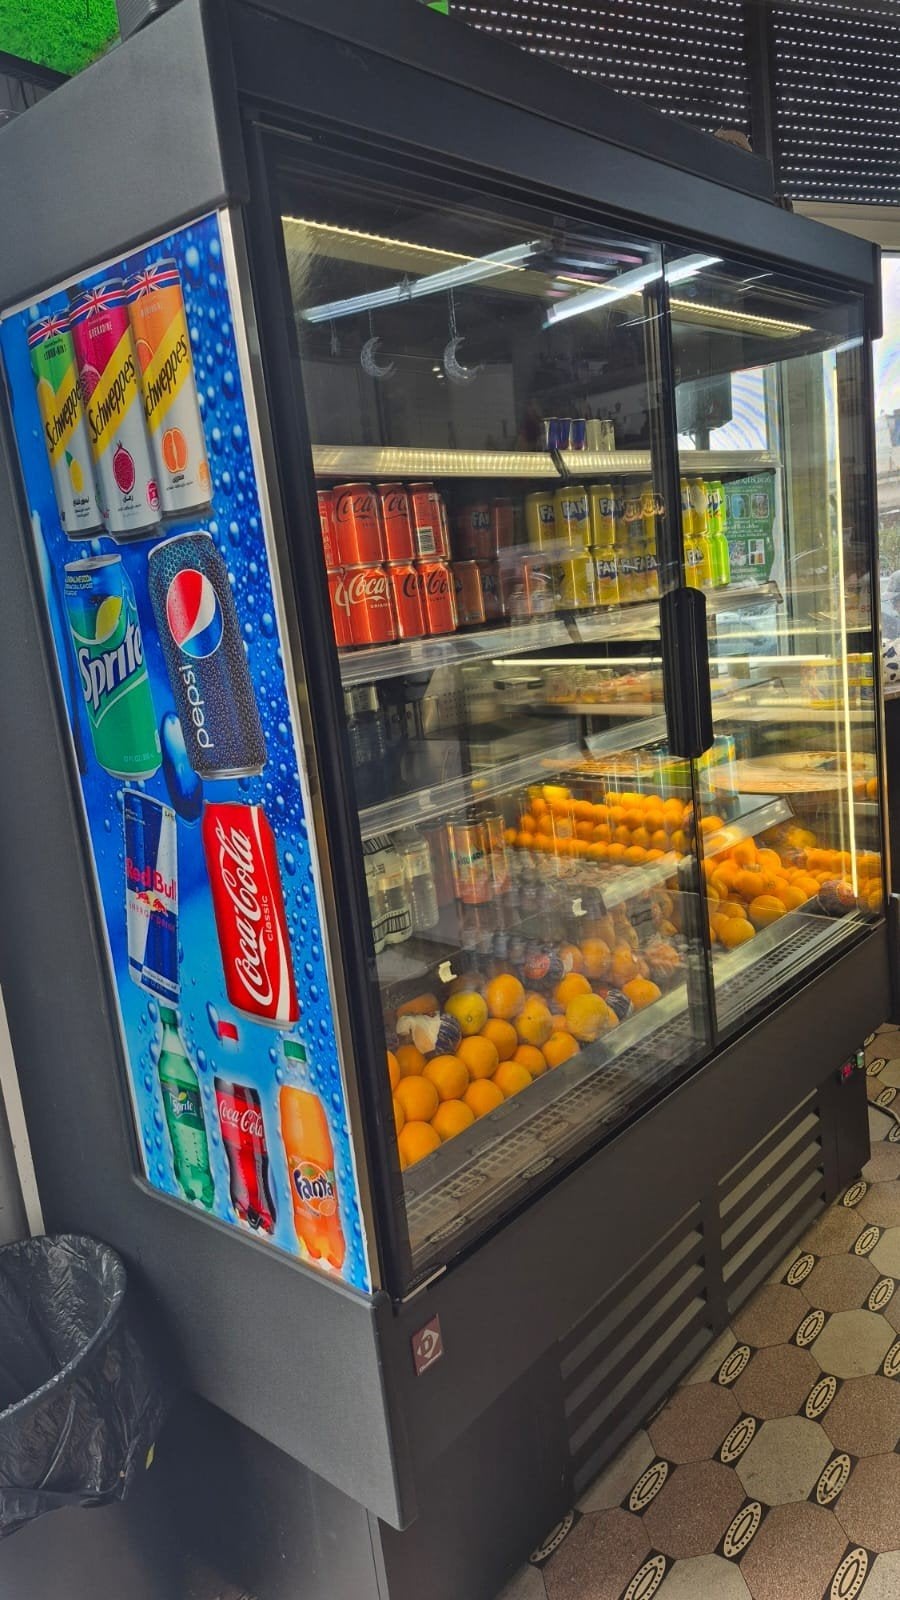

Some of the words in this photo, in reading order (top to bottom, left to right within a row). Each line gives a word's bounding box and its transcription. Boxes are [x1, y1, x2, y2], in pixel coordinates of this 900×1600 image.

[46, 380, 81, 453] Schweppe
[89, 354, 135, 444] Schweppes
[179, 664, 215, 748] pepsi
[126, 857, 151, 888] Red
[154, 870, 177, 902] Bull
[261, 895, 274, 941] classic
[172, 1100, 193, 1113] Sprite
[294, 1169, 335, 1200] Fanta
